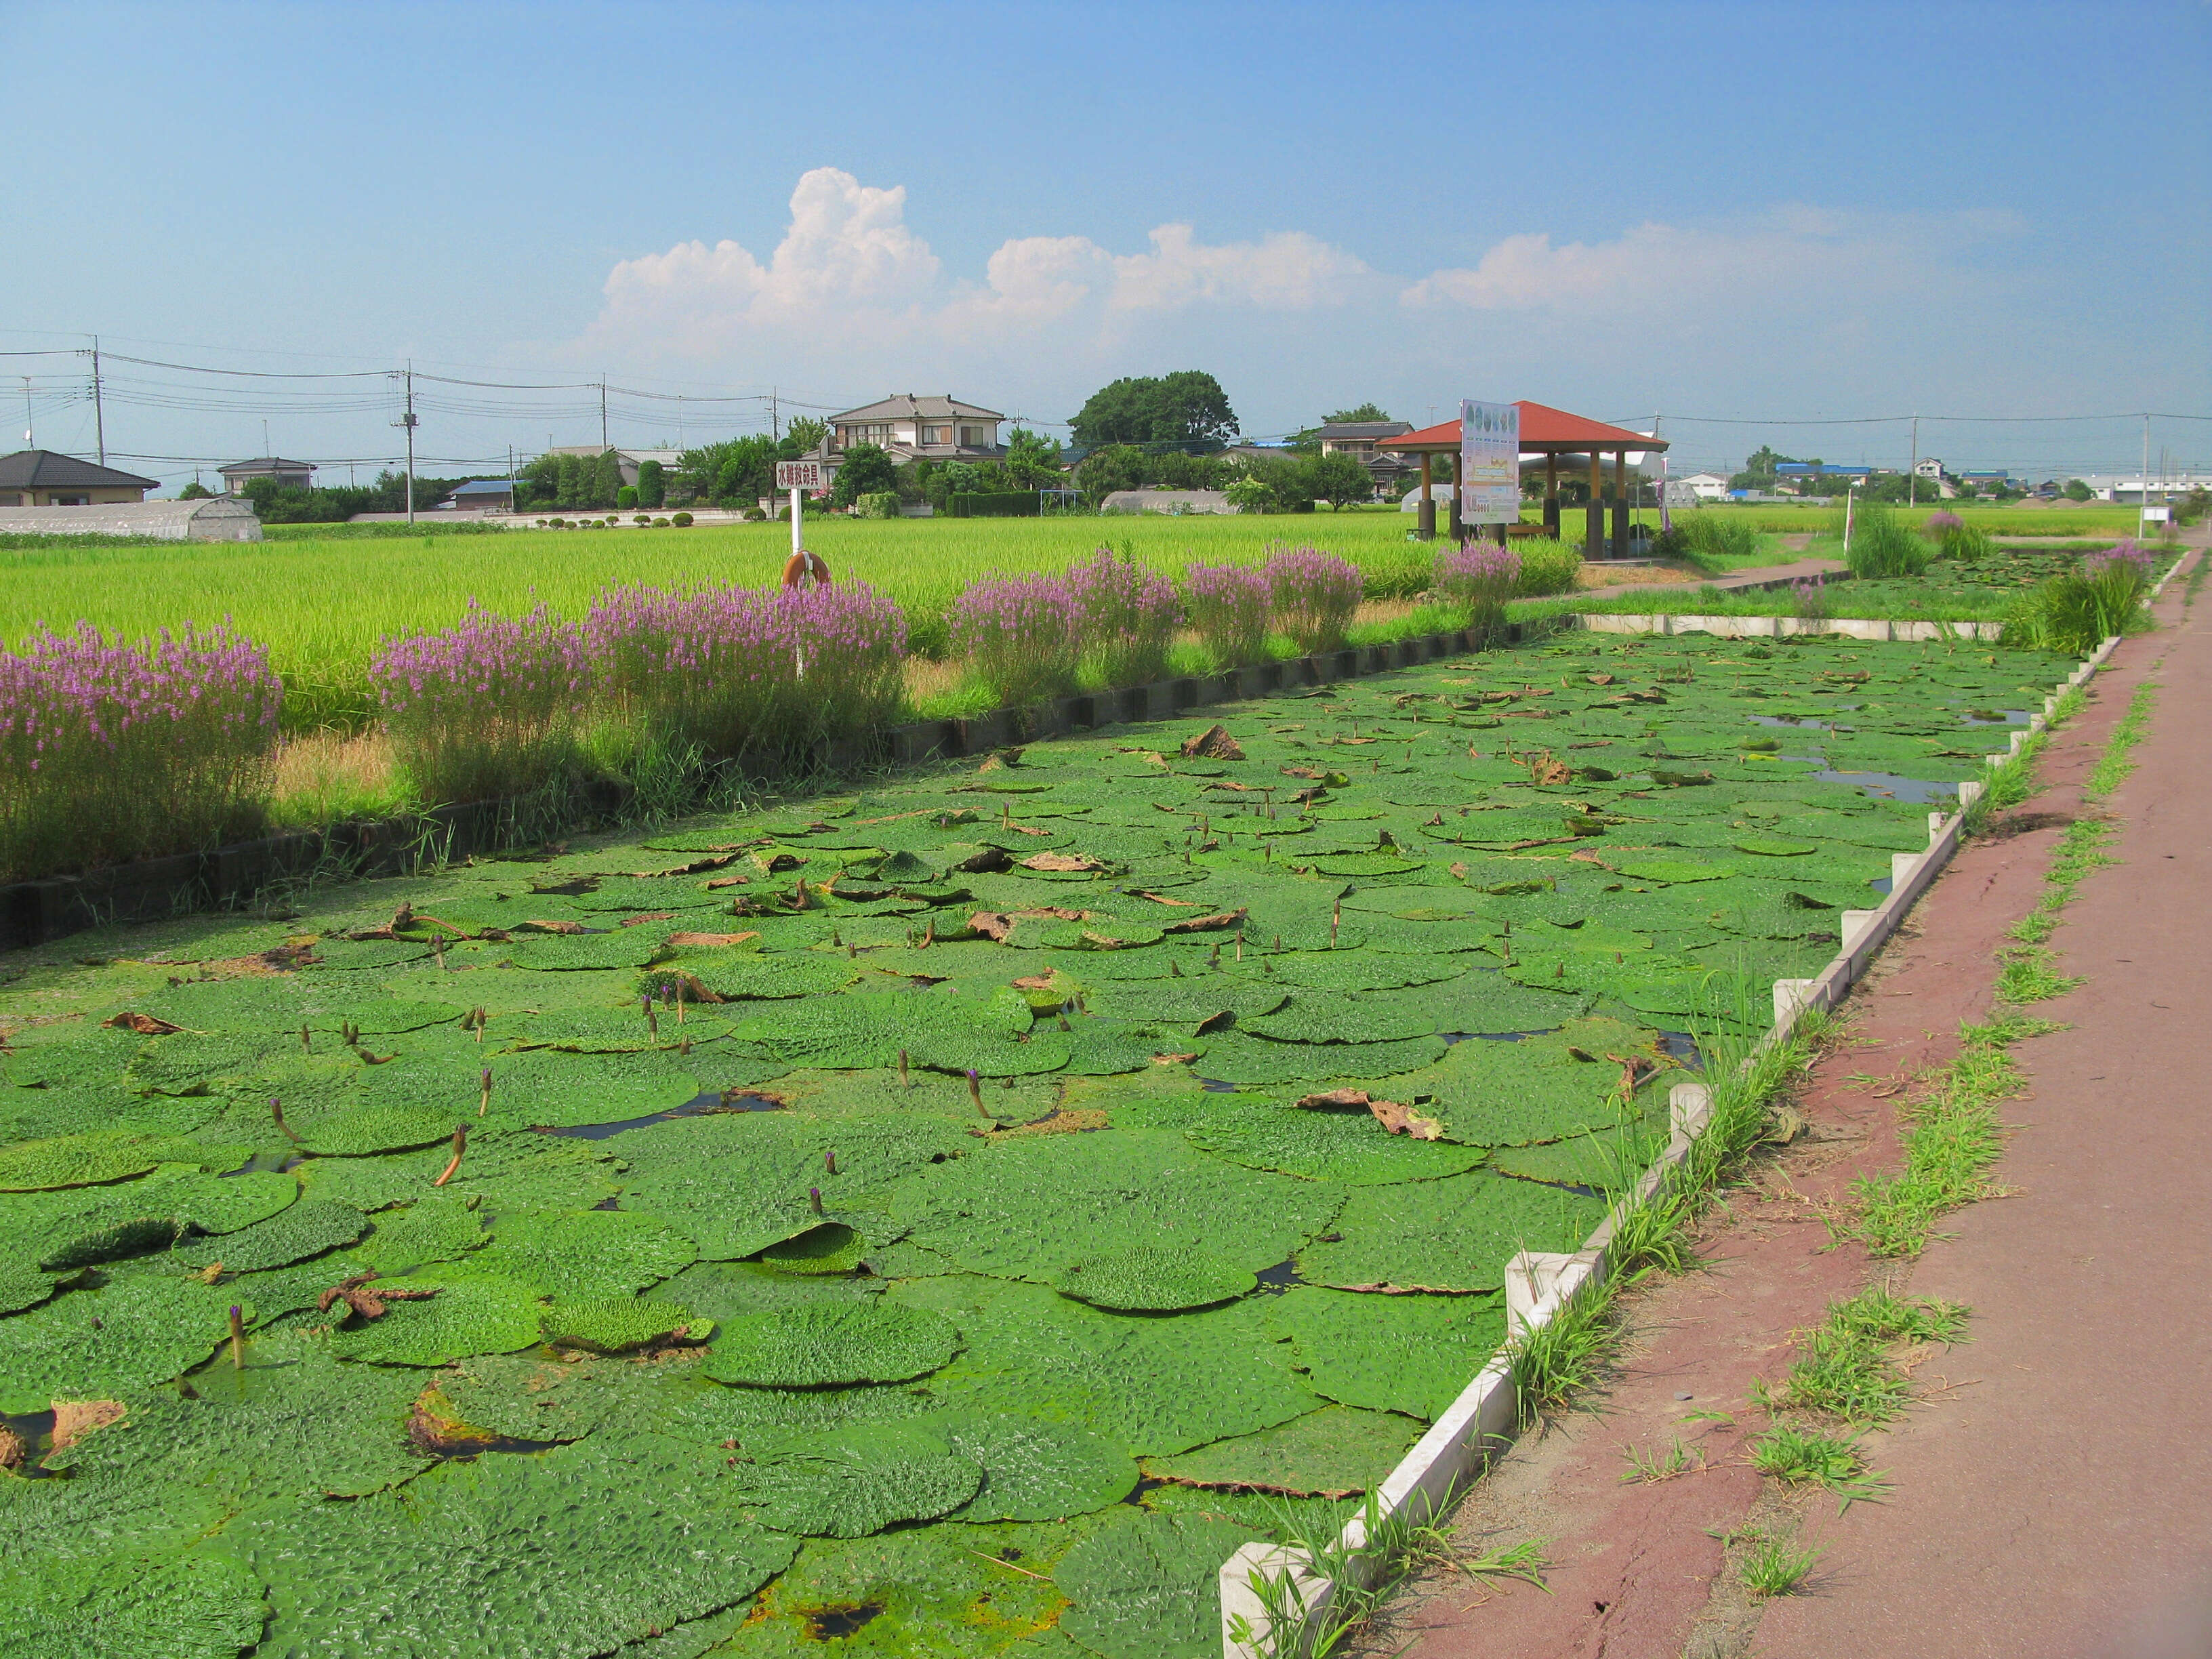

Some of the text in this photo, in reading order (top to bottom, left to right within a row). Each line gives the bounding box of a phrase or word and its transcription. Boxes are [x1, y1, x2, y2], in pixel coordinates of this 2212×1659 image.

[779, 464, 819, 487] 水難救命具
